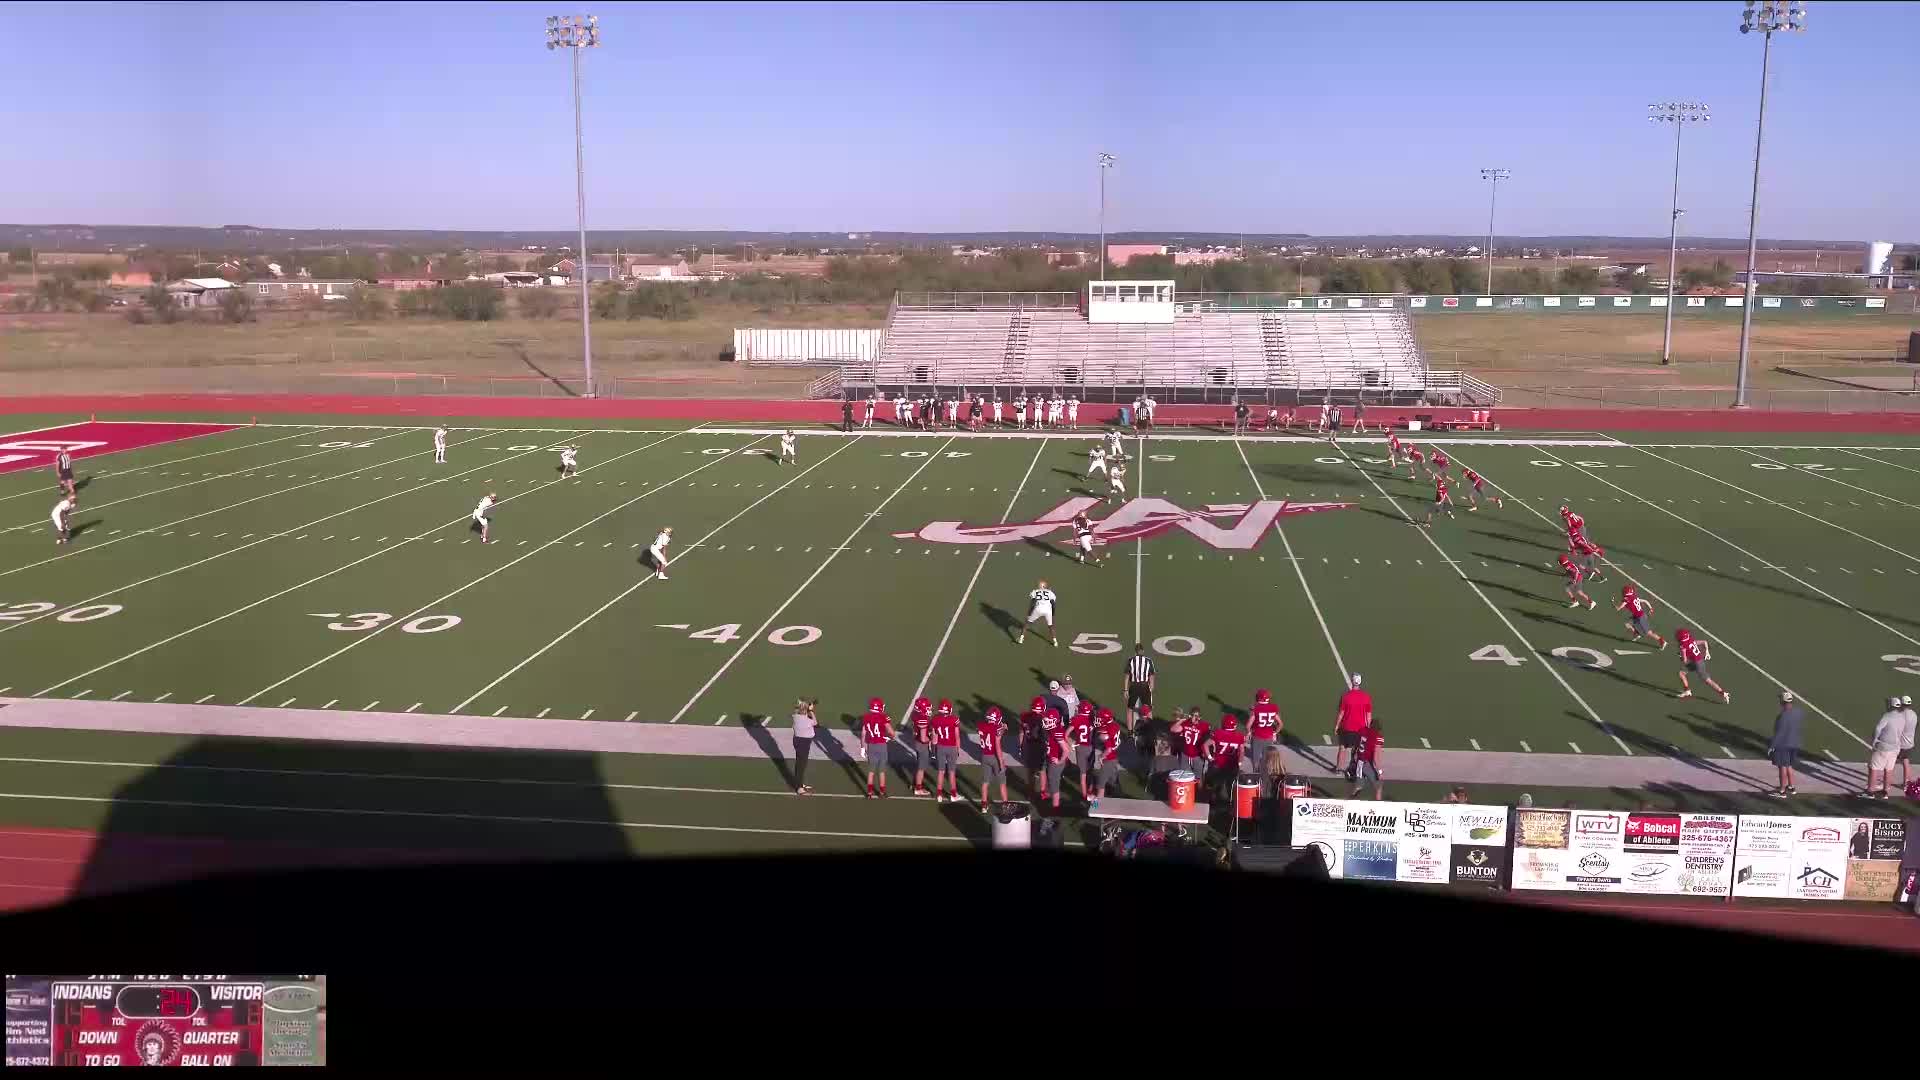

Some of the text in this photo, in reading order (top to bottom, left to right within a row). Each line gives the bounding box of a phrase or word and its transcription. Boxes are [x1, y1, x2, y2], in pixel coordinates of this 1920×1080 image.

[1035, 591, 1050, 601] 55
[327, 612, 462, 634] 30
[689, 622, 823, 646] 40
[1068, 632, 1207, 656] 50
[1468, 644, 1614, 669] 40
[1258, 712, 1276, 727] 55
[866, 723, 881, 738] 14
[937, 726, 950, 739] 11
[1079, 725, 1088, 743] 2
[1346, 812, 1397, 827] MAXIMUM
[1581, 820, 1613, 830] WTV
[1643, 822, 1677, 834] Bobcat
[1878, 822, 1903, 830] LUCY
[1874, 828, 1905, 837] BISHOP
[1632, 835, 1641, 843] of
[1642, 836, 1671, 845] Abilene
[1684, 855, 1725, 863] CHILDREN'S
[1456, 866, 1498, 877] BUNTON
[1685, 863, 1724, 871] DENTISTRY
